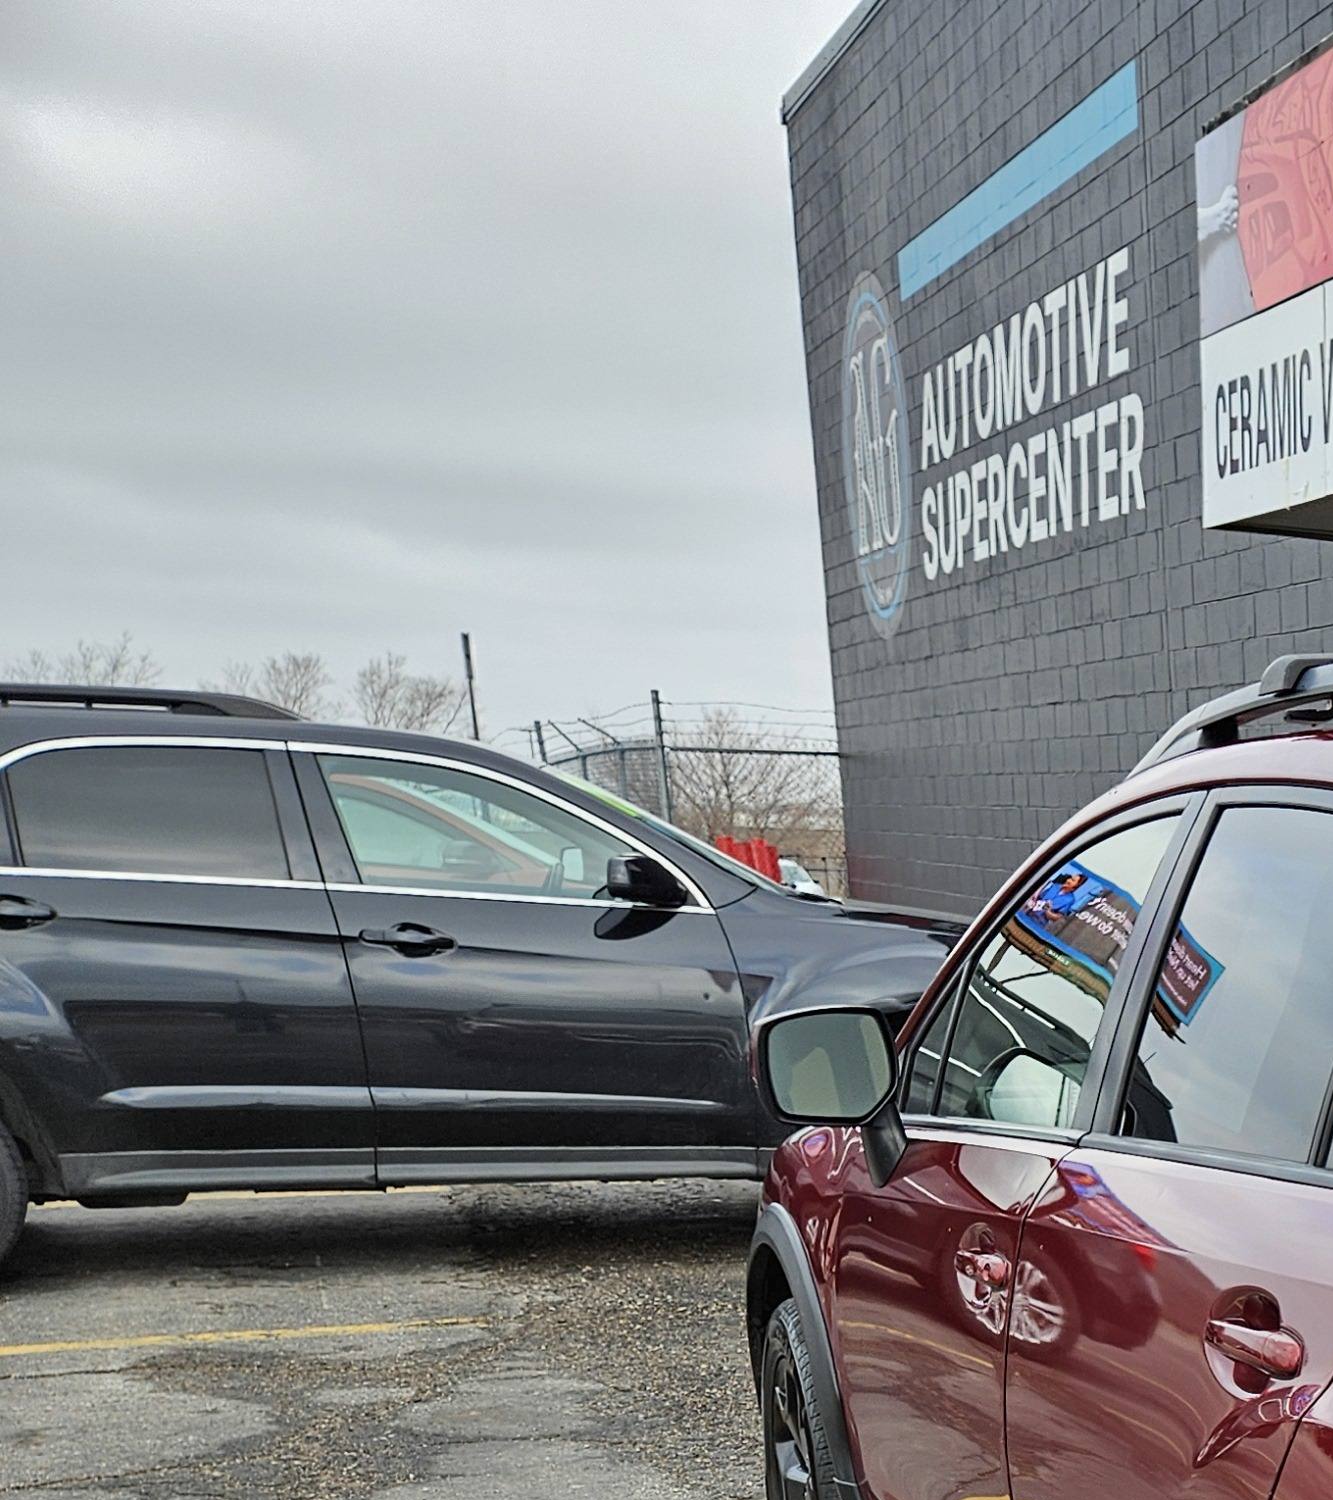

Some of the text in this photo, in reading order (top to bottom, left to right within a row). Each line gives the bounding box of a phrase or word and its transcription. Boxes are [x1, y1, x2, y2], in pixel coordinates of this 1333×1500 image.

[921, 248, 1130, 471] AUTOMOTIVE
[1216, 348, 1312, 479] CERAMIC
[921, 392, 1146, 581] SUPERCENTER
